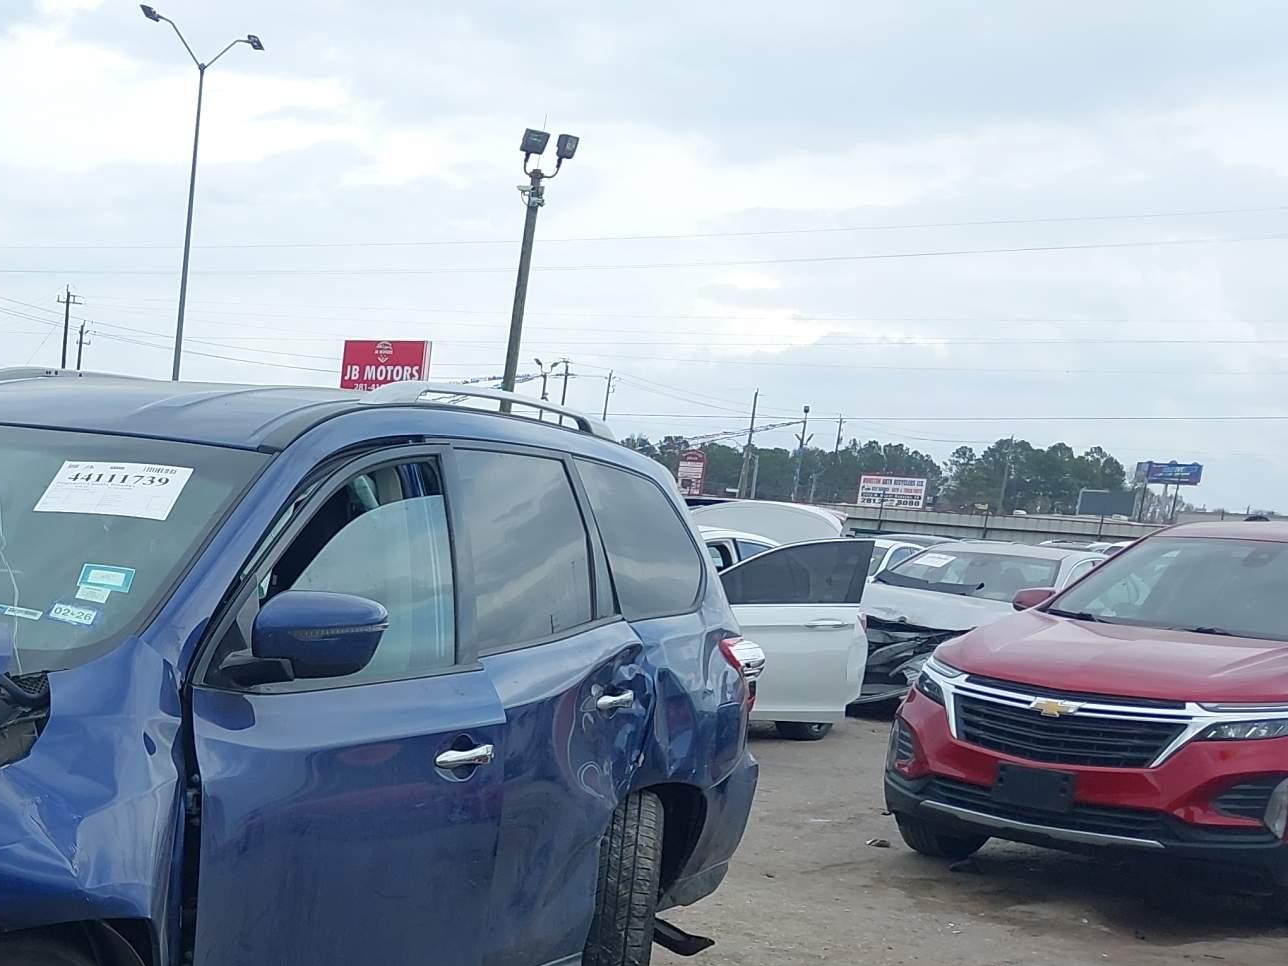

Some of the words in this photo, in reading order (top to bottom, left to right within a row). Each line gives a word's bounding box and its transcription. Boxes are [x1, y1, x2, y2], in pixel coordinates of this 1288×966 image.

[344, 365, 360, 380] JB
[364, 365, 419, 381] MOTORS
[68, 472, 170, 487] 44111739
